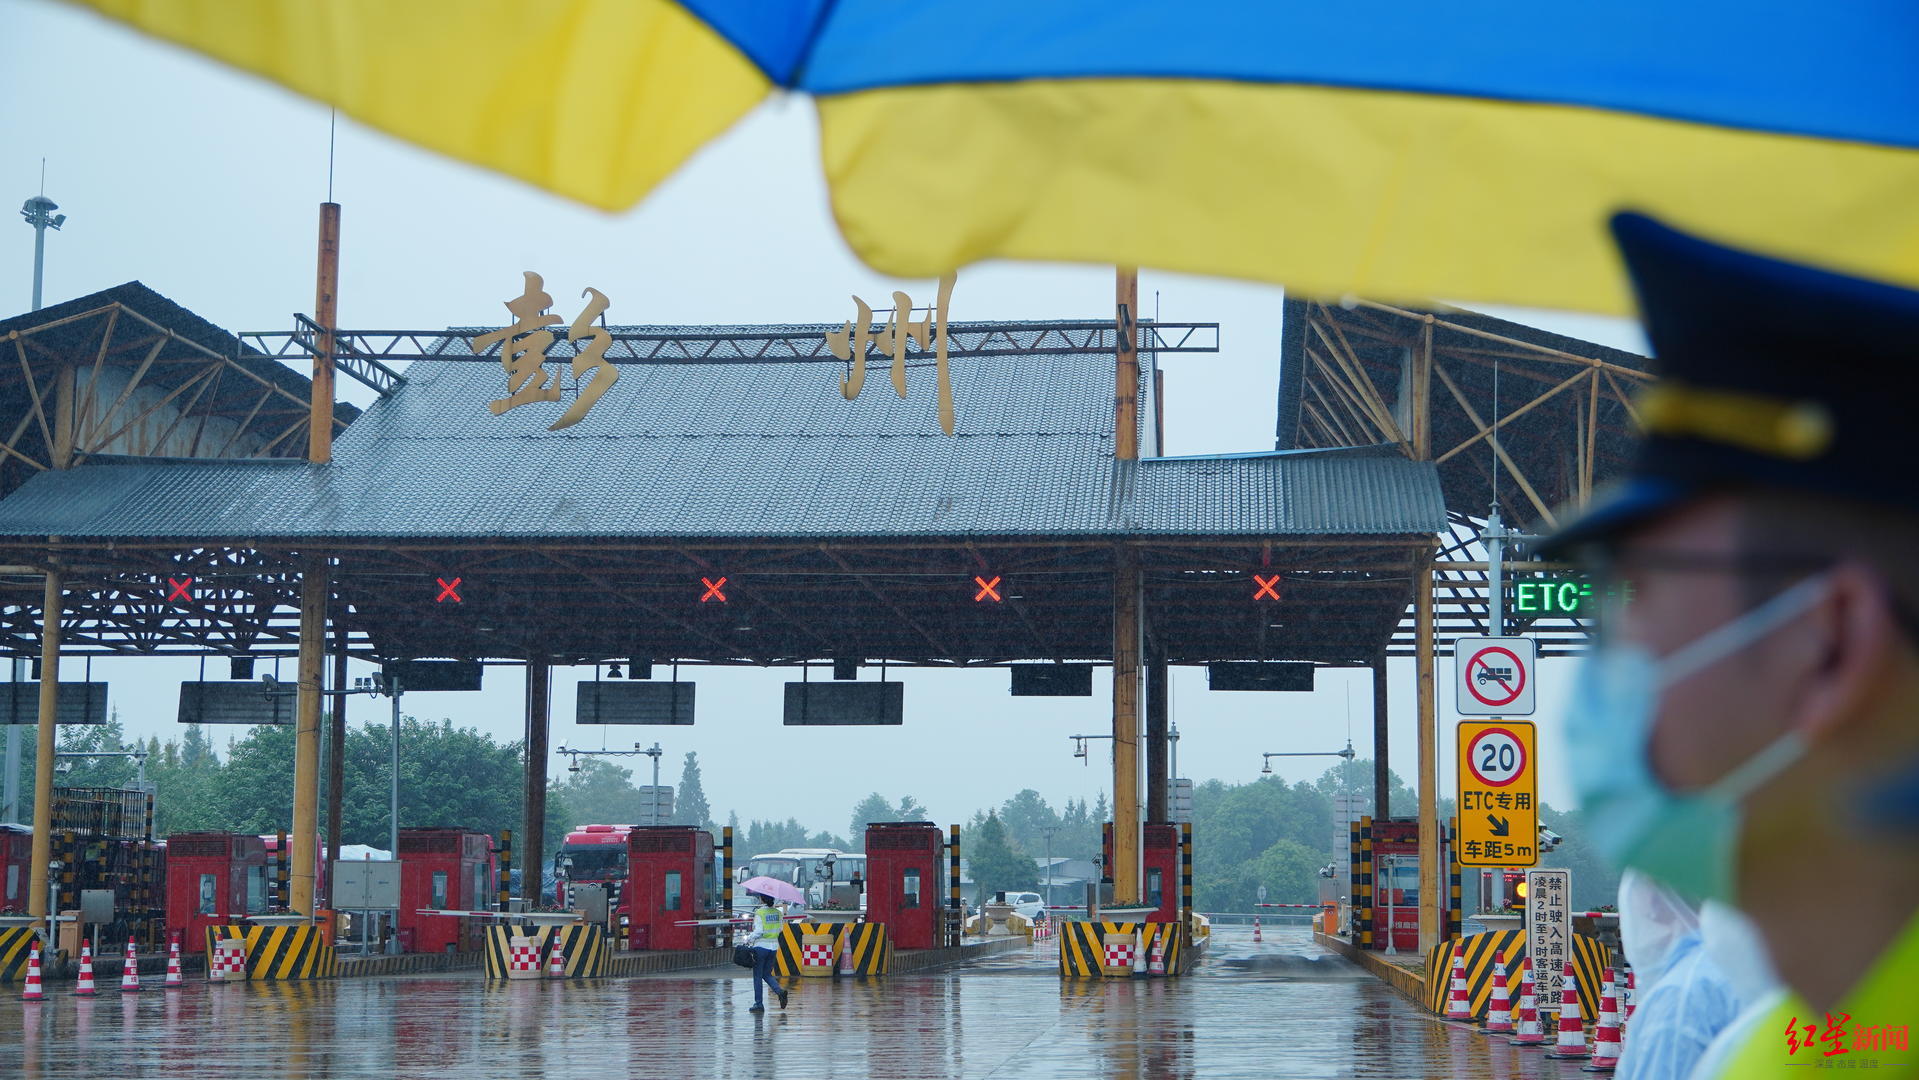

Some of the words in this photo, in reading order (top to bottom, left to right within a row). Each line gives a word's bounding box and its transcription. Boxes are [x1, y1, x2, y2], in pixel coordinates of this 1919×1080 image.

[472, 271, 957, 436] 彭州
[1481, 743, 1515, 772] 20
[1463, 791, 1531, 811] ETC专用
[1464, 839, 1532, 859] 车距5m
[1534, 876, 1549, 1004] 凌晨2时至5时客运车辆
[1548, 876, 1563, 1004] 禁止驶入高速公路
